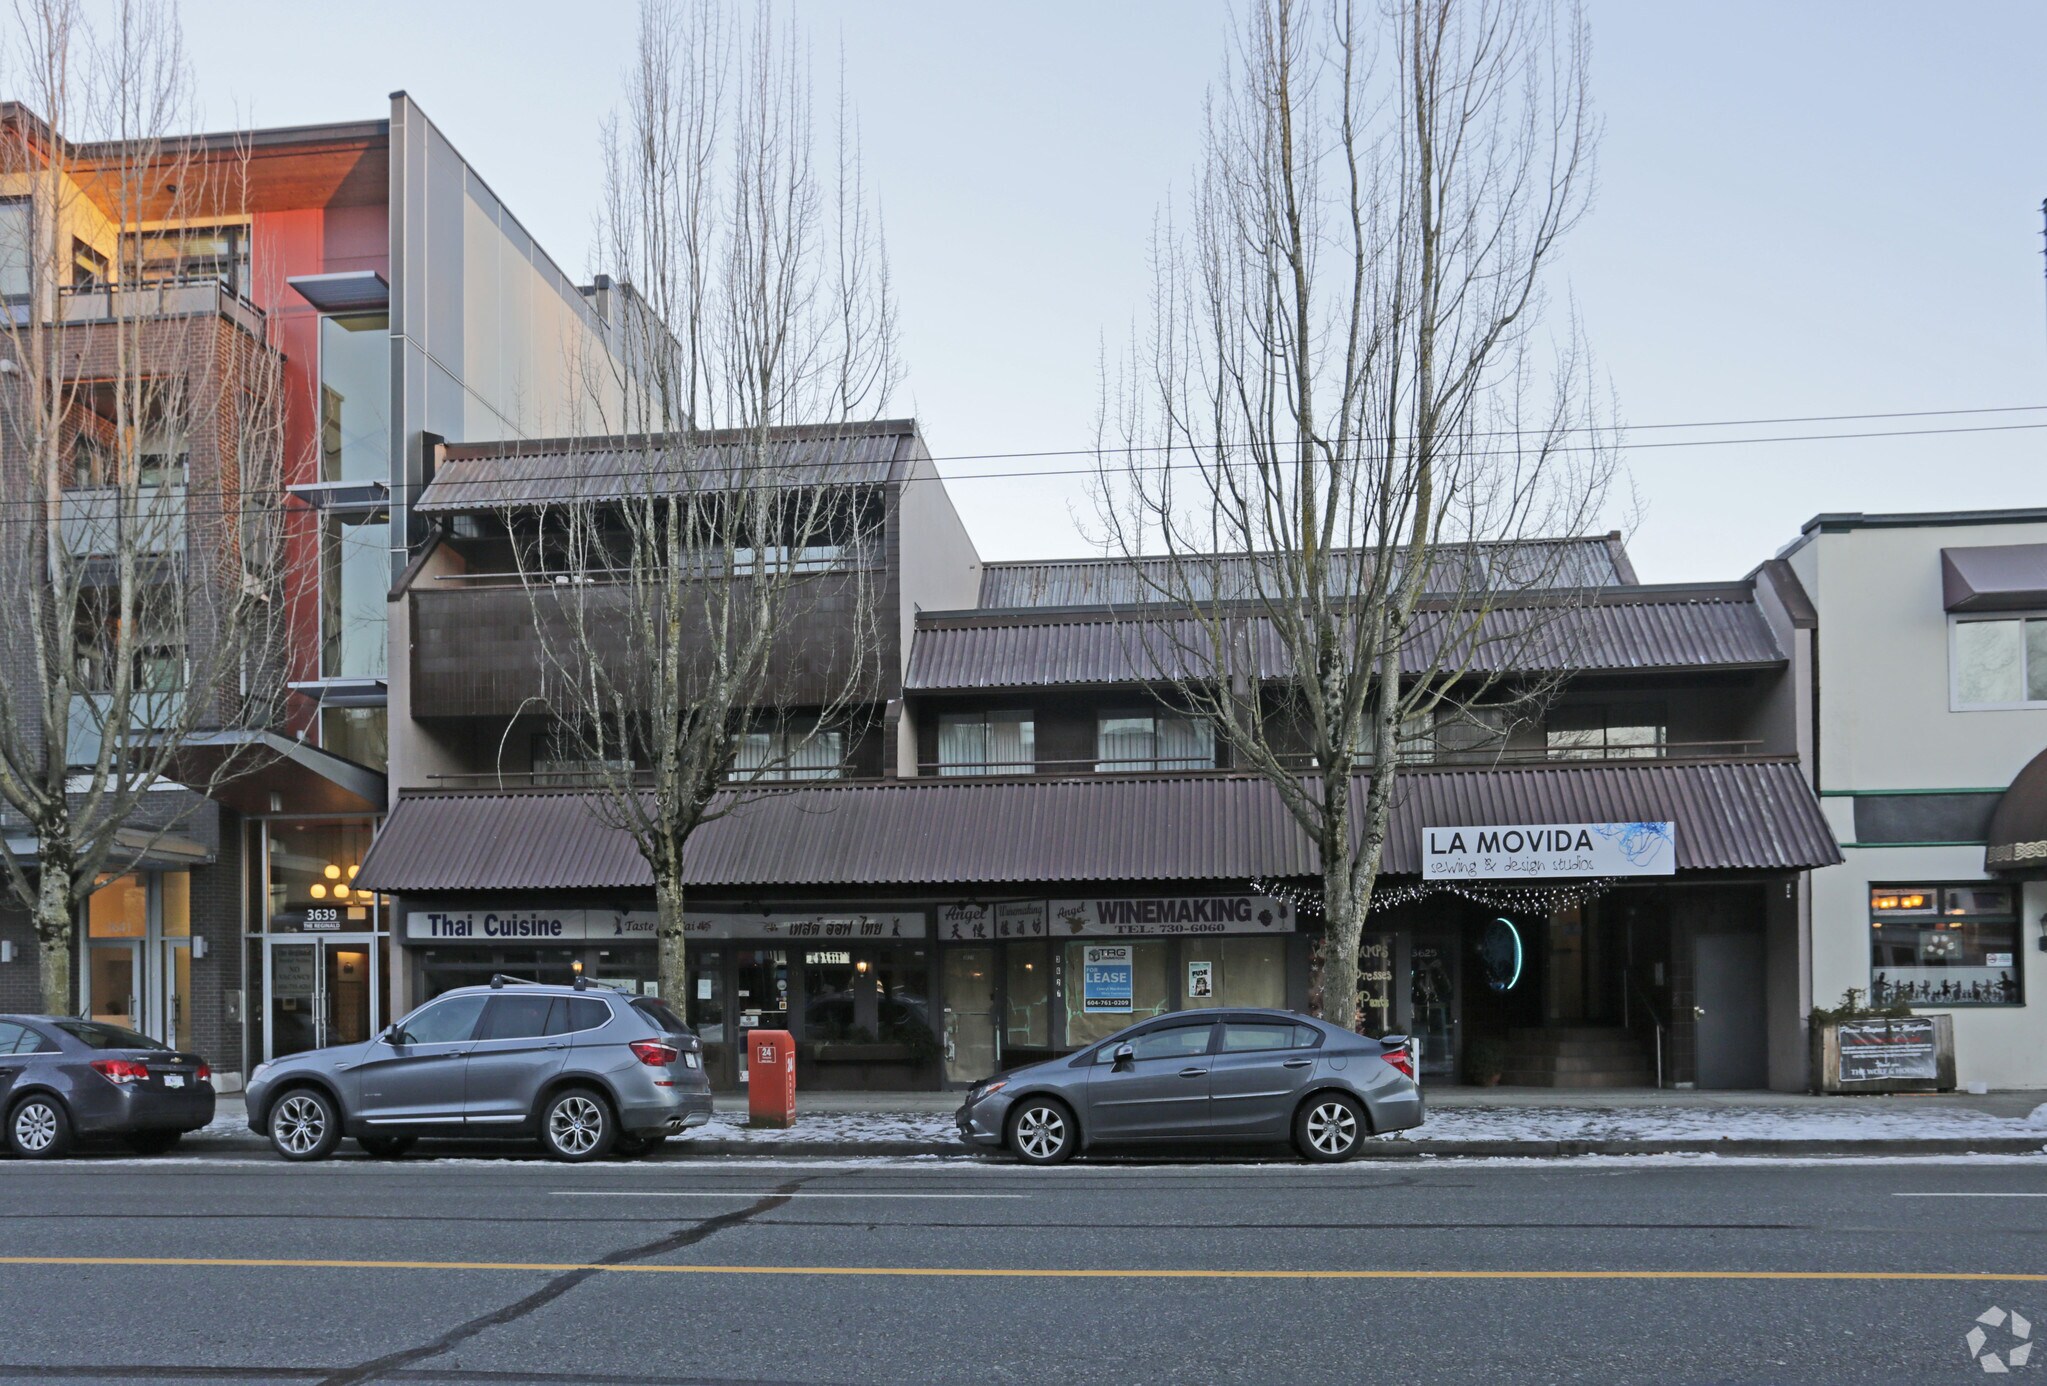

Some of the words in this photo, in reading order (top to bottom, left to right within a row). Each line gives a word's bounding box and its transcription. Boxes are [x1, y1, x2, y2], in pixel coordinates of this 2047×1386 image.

[1431, 832, 1467, 855] LA
[1476, 829, 1594, 854] MOVIDA
[1431, 857, 1477, 877] sewing
[1484, 857, 1496, 872] &
[1503, 855, 1546, 876] design
[1552, 855, 1594, 871] studios
[307, 909, 337, 921] 3639
[945, 904, 987, 925] Angel
[1056, 902, 1086, 918] Angel
[1096, 898, 1252, 924] WINEMAKING
[427, 914, 473, 936] Thai
[484, 913, 562, 936] Cuisine
[624, 920, 654, 931] Taste
[1115, 924, 1153, 934] TEL:
[1159, 923, 1225, 933] 730-6060
[1099, 948, 1126, 957] TRG
[1411, 948, 1438, 958] 3625
[1086, 972, 1127, 983] LEASE
[762, 1048, 771, 1057] 24
